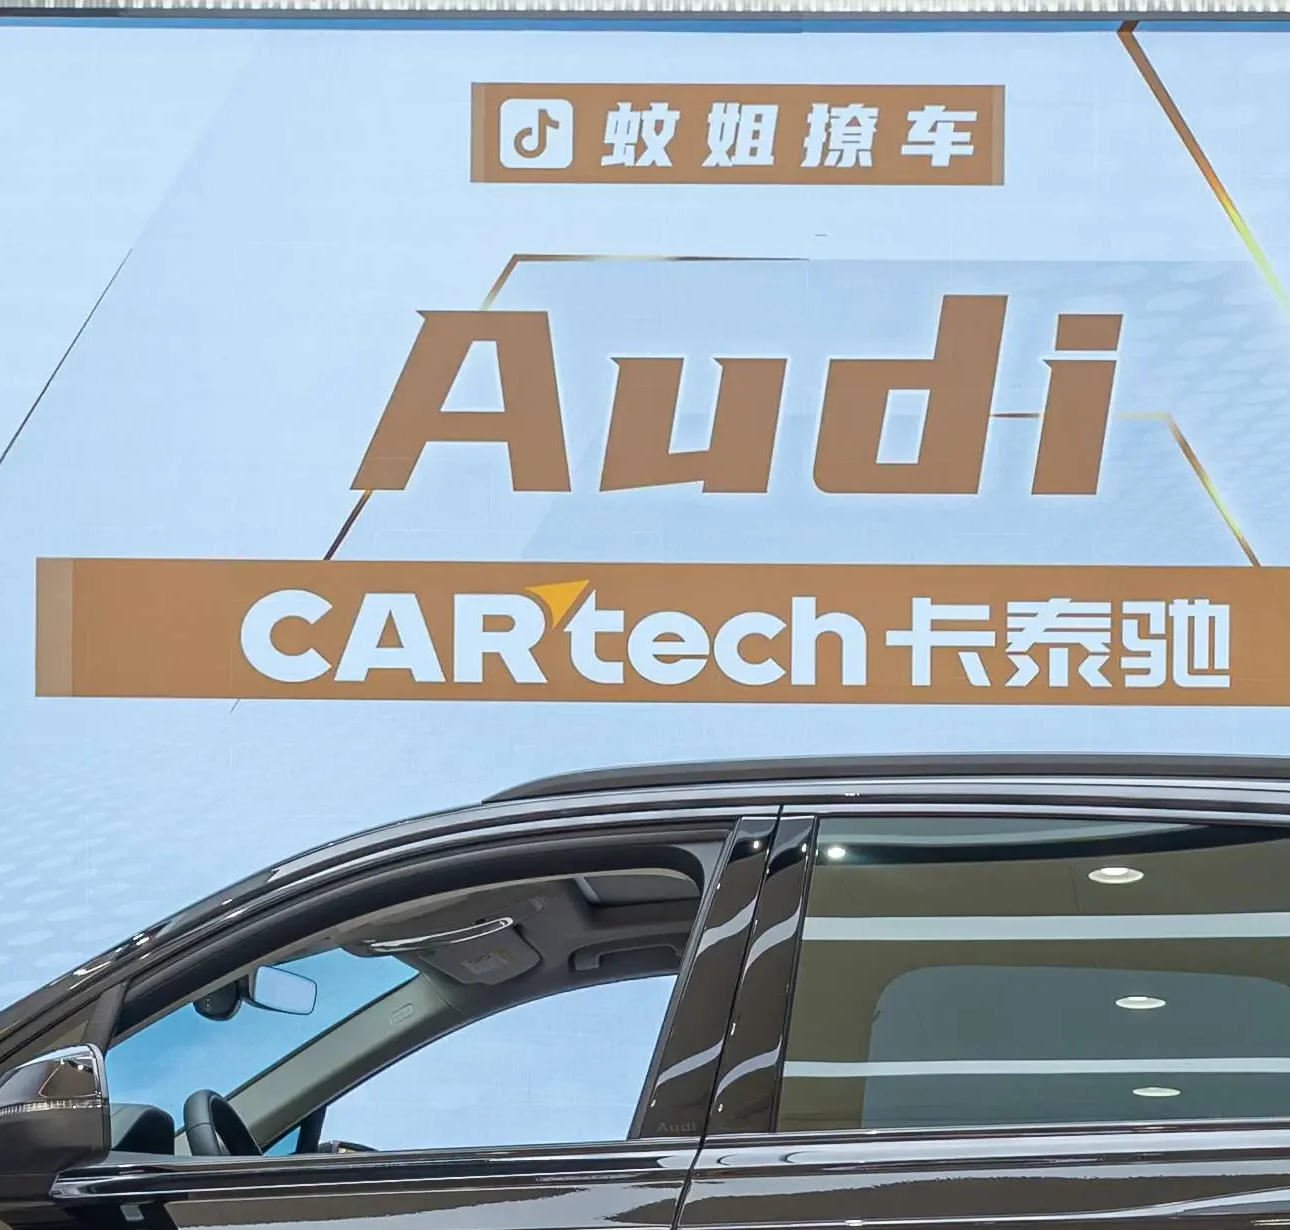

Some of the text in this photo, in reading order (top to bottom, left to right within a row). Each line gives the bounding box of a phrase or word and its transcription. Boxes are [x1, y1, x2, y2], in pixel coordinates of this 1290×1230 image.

[600, 102, 978, 168] 蚊姐撩车
[350, 295, 1124, 496] Audi
[885, 597, 1231, 688] 卡泰驰
